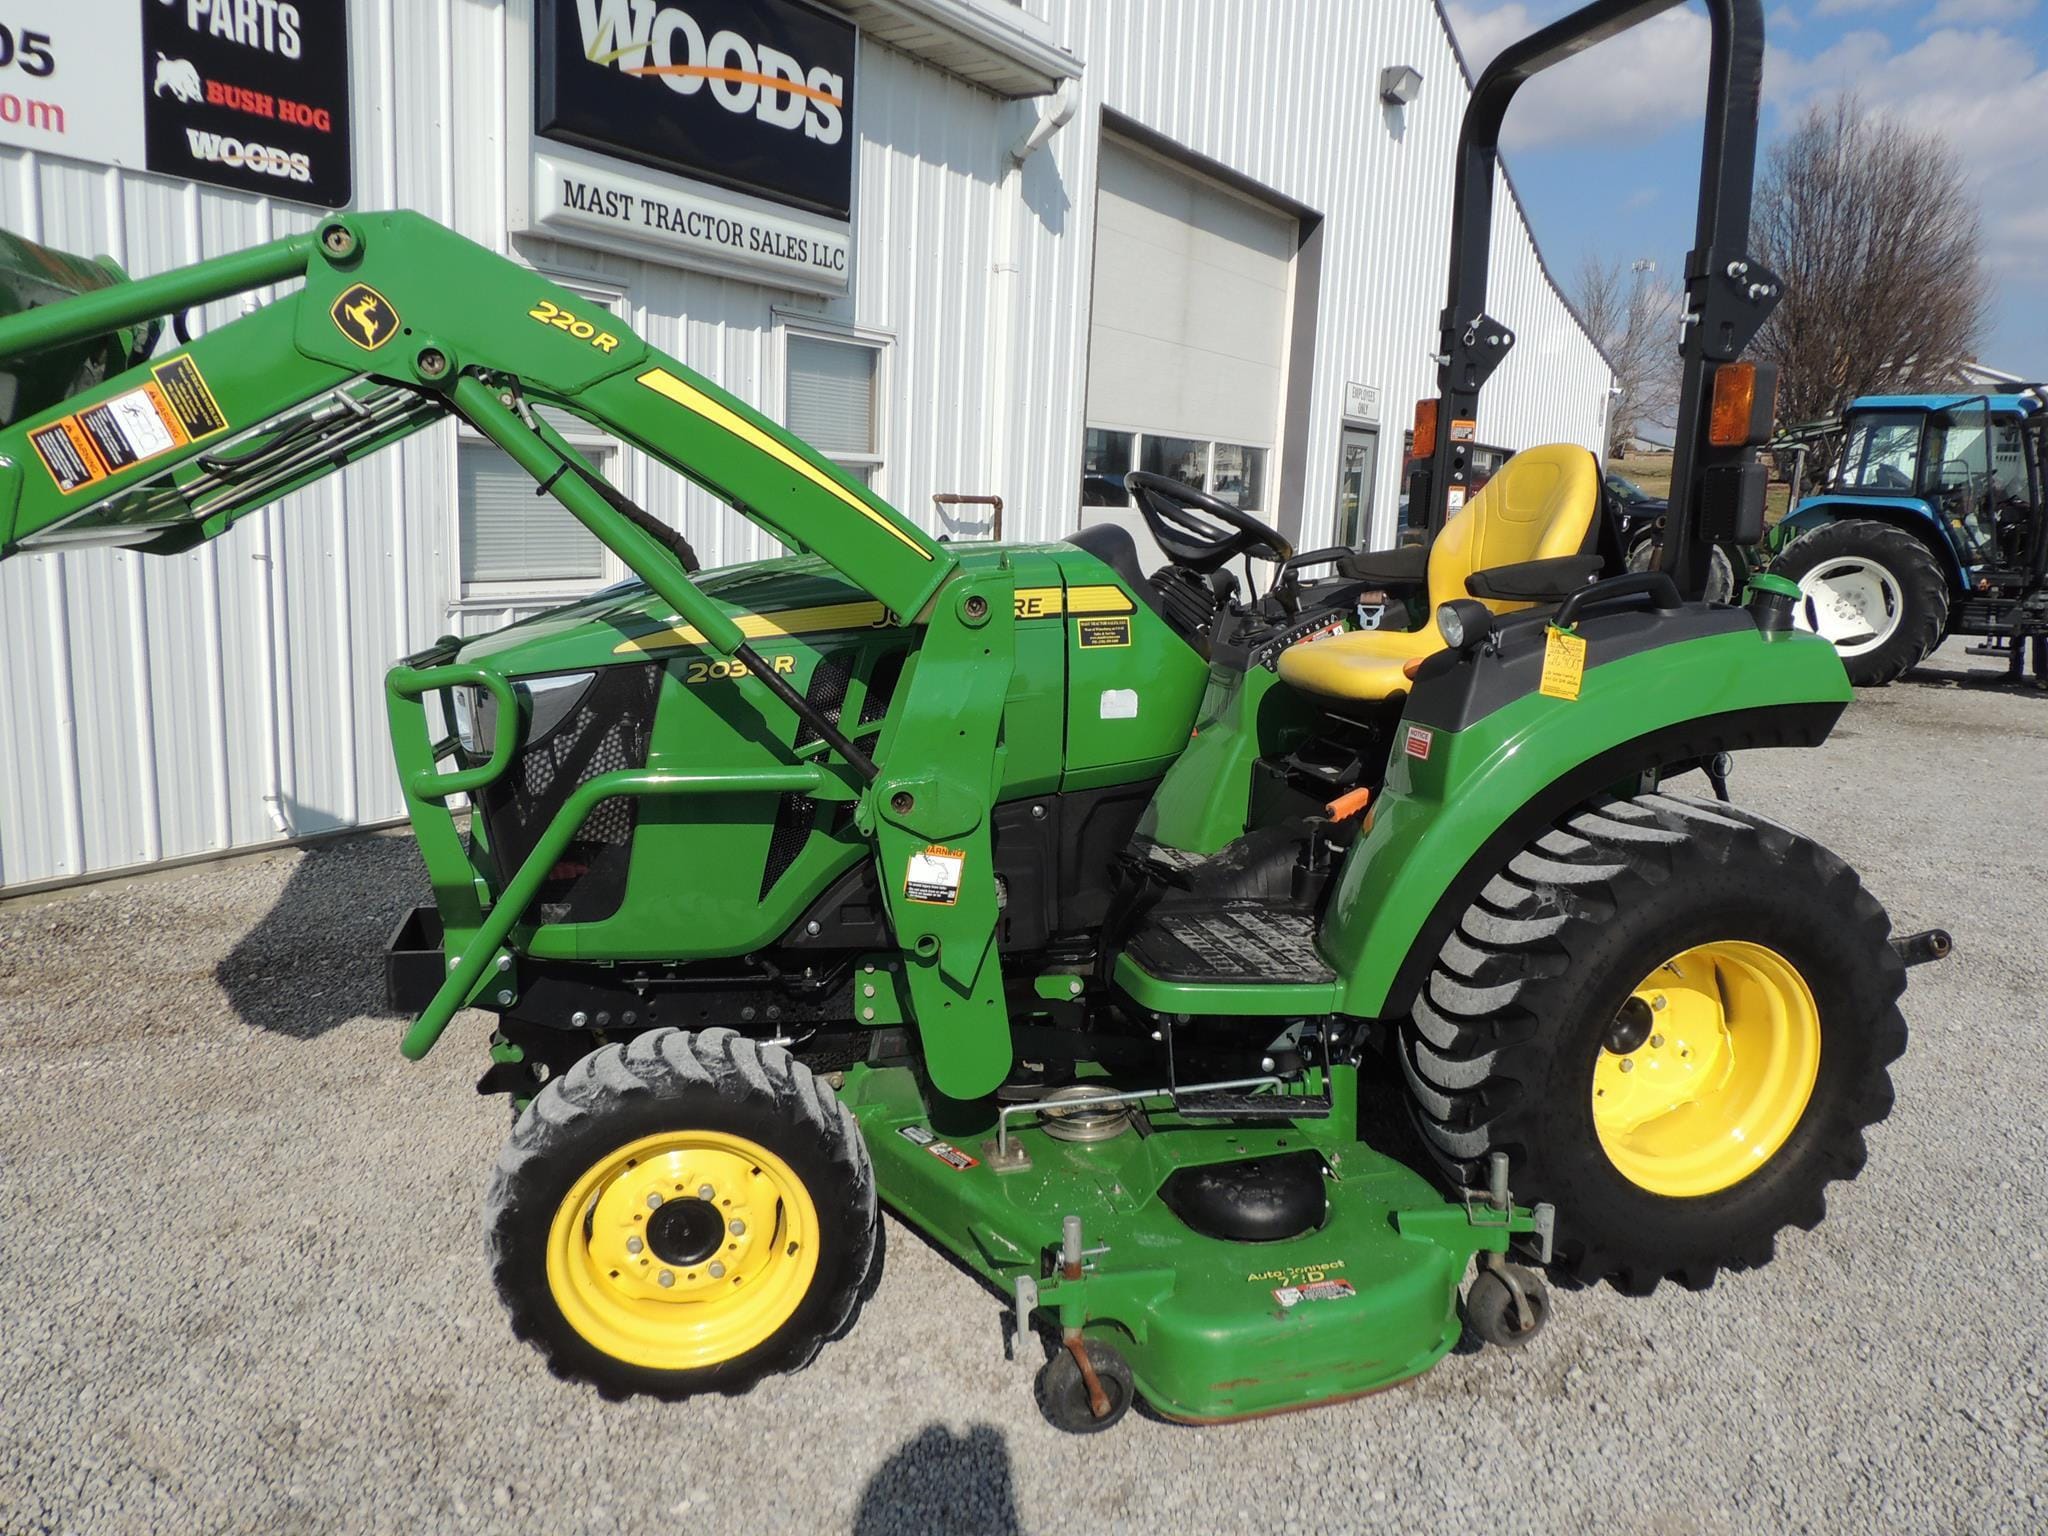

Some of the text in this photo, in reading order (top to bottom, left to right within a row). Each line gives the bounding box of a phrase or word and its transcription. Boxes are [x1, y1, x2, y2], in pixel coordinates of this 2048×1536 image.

[187, 0, 301, 59] PARTS
[577, 0, 843, 144] WOODS
[206, 79, 331, 132] BUSH HOG
[186, 128, 311, 183] WOODS
[563, 179, 845, 271] MAST TRACTOR SALES LLC
[527, 301, 620, 355] 220 R
[1358, 402, 1368, 415] ONLY
[686, 655, 796, 685] 203 R
